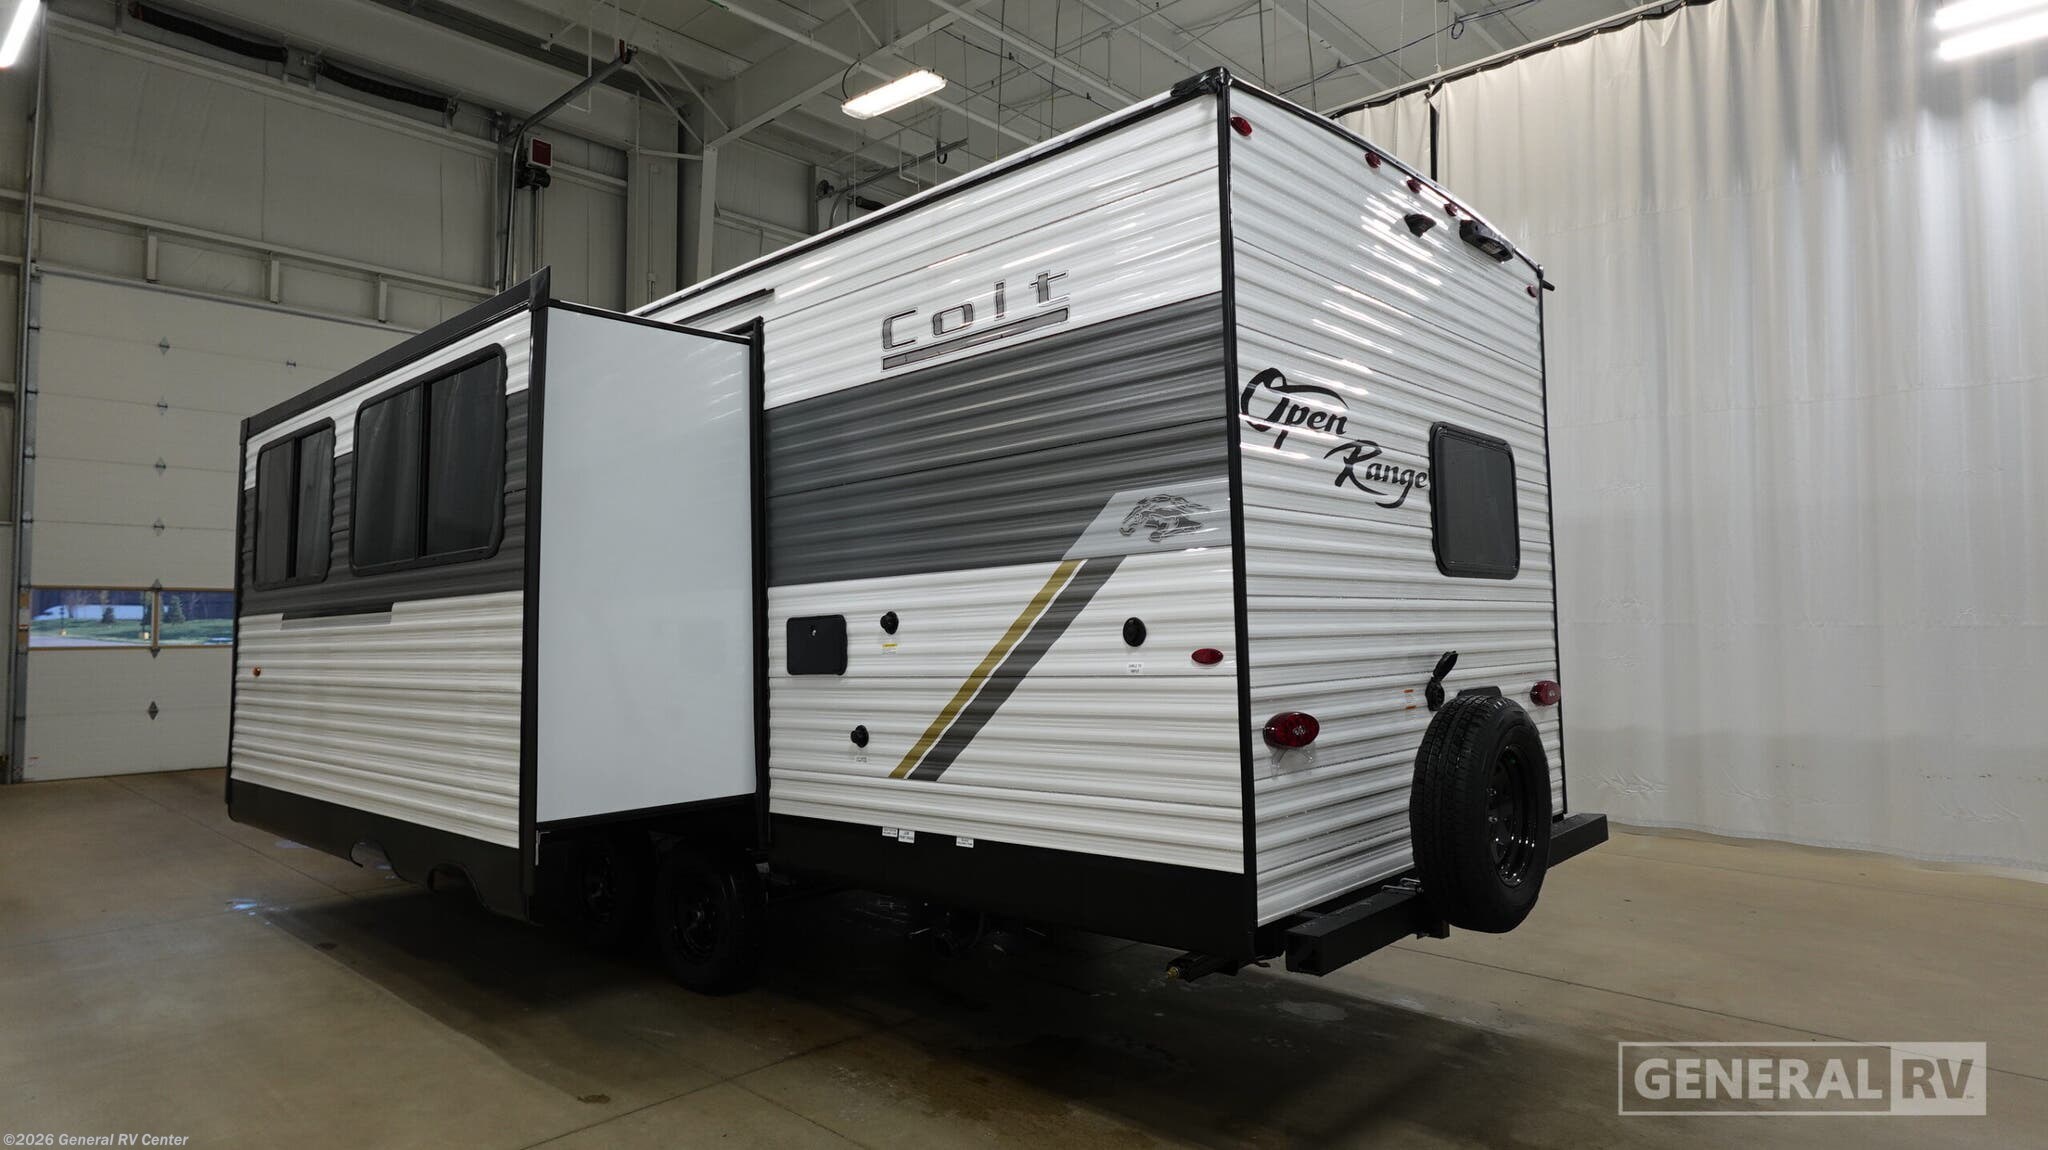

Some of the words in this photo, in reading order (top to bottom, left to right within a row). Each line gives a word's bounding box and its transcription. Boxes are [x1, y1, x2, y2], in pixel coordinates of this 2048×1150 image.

[882, 271, 1070, 350] Colt
[1241, 368, 1349, 449] Open
[1323, 440, 1428, 508] Range
